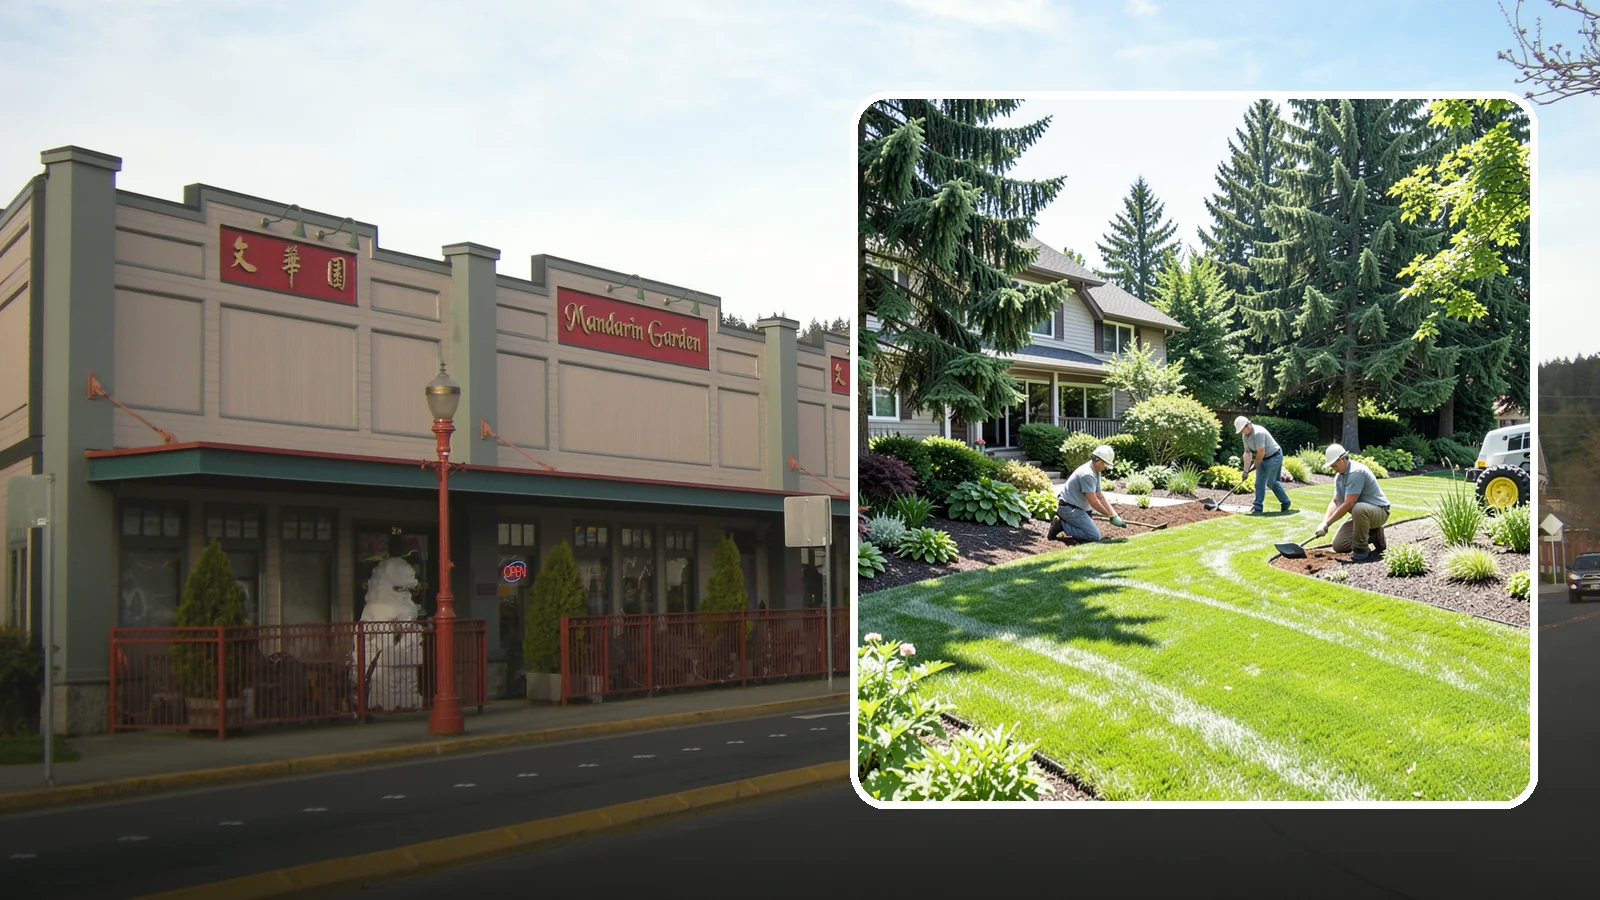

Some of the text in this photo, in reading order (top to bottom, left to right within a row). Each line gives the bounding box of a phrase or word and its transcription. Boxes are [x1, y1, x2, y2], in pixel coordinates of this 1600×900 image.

[231, 235, 346, 291] 文華園
[564, 301, 702, 353] Mandarin Garden
[834, 363, 847, 386] 文
[503, 565, 527, 578] OPEN
